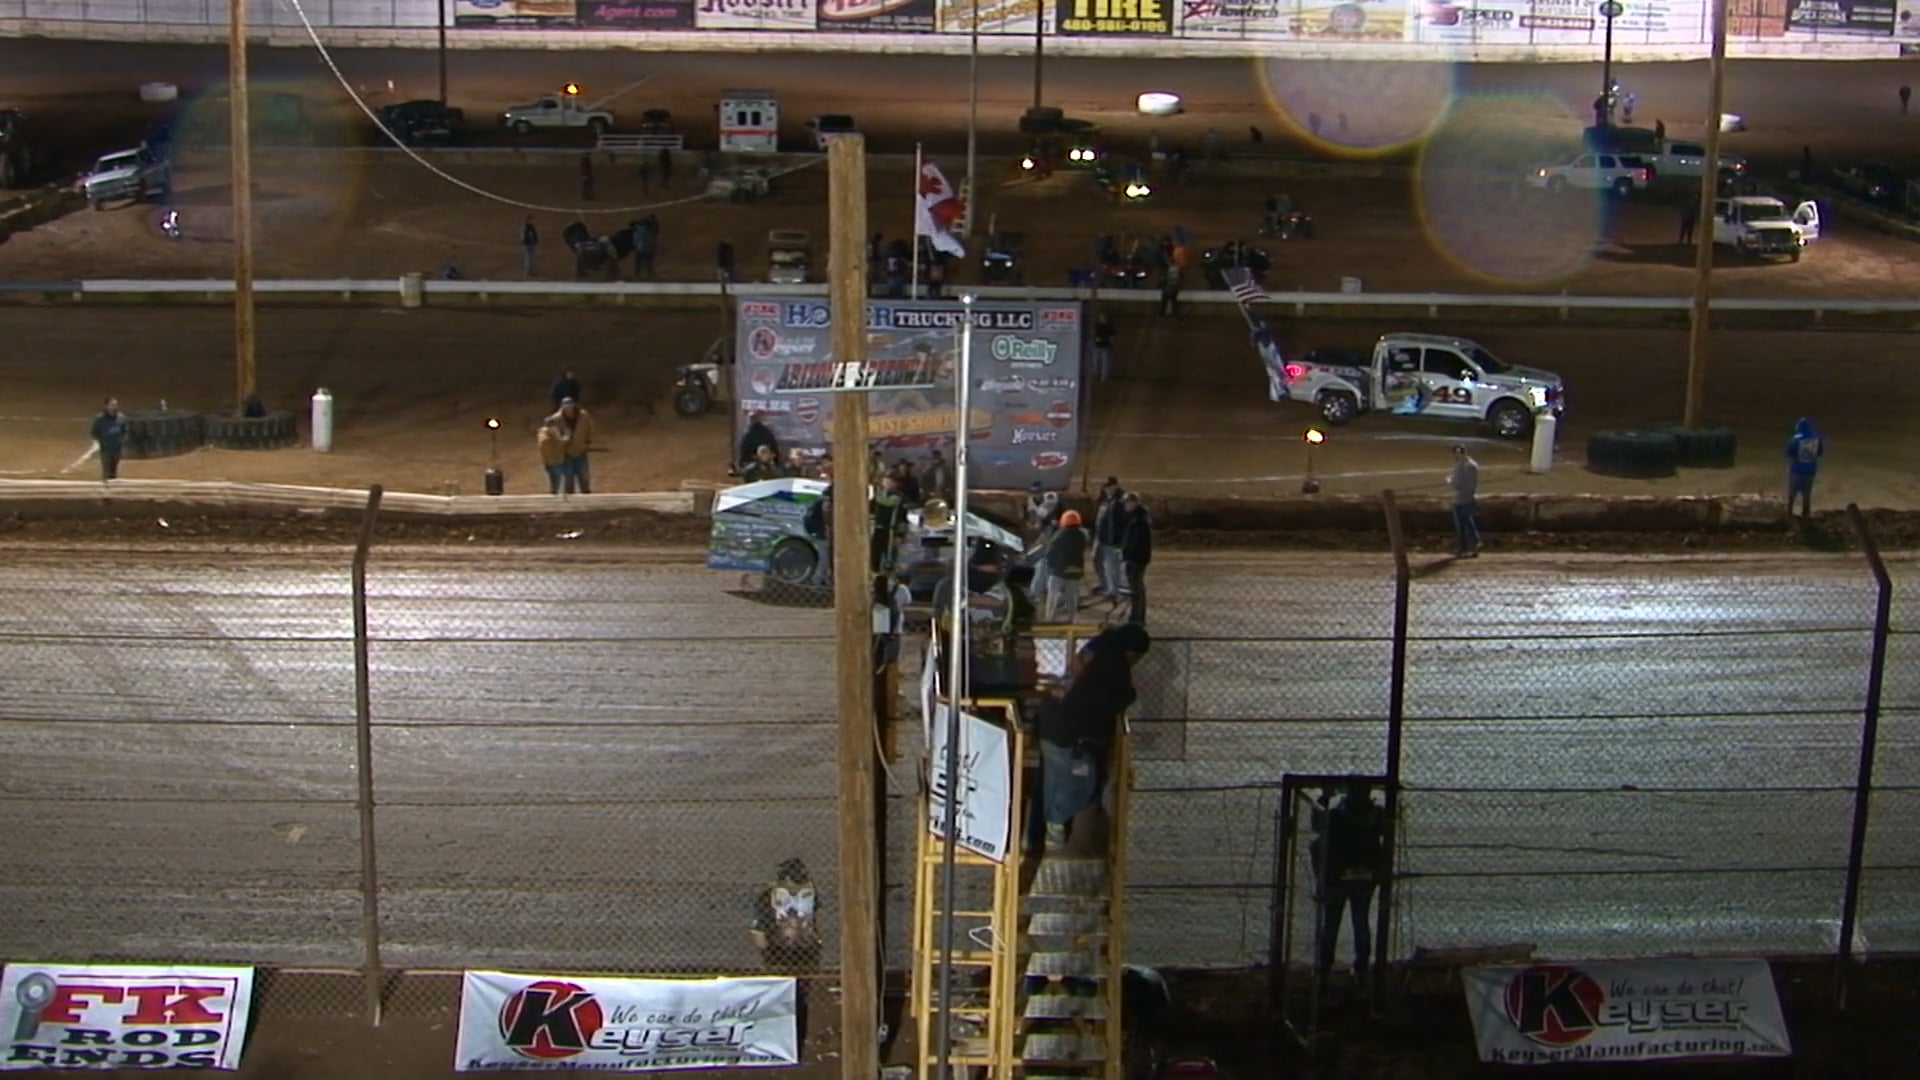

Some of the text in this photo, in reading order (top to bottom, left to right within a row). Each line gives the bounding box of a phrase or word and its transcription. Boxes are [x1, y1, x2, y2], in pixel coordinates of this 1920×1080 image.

[593, 5, 678, 20] Agent.com
[895, 310, 992, 328] TRUCKING
[996, 313, 1032, 329] LLC
[1609, 978, 1636, 998] We
[1643, 985, 1670, 996] can
[1676, 979, 1694, 996] do
[40, 985, 226, 1025] FK
[610, 1004, 638, 1025] We
[646, 1012, 677, 1025] can
[682, 1008, 703, 1024] do
[60, 1028, 222, 1047] ROD
[6, 1044, 218, 1068] ENDS
